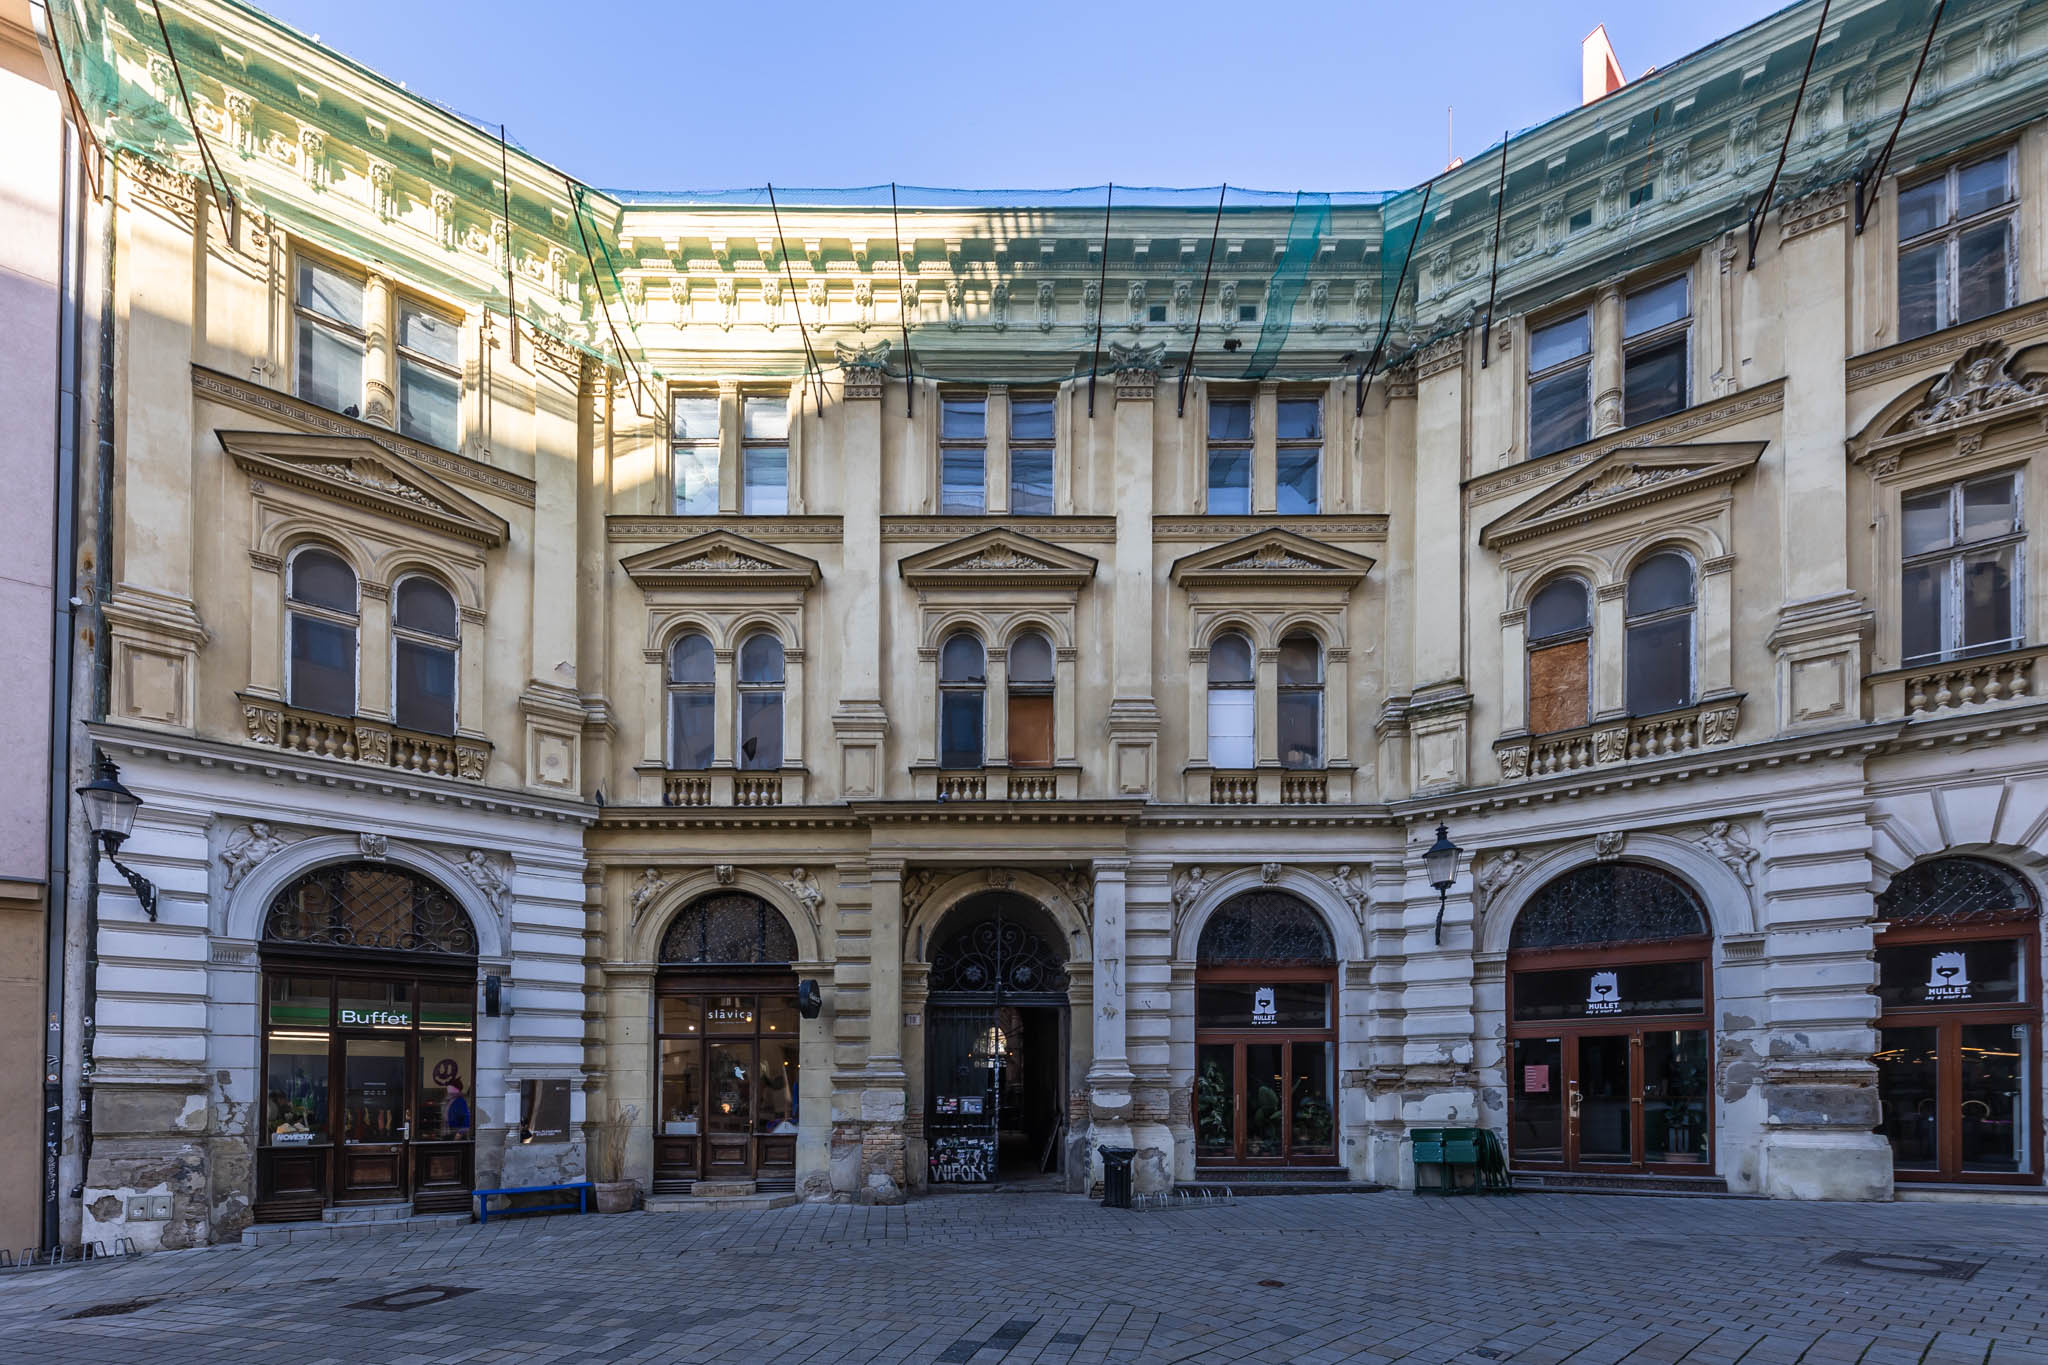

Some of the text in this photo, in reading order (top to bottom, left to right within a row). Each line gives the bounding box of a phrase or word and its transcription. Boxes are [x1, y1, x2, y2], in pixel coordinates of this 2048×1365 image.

[1928, 986, 1968, 995] MULLET
[1588, 1002, 1619, 1010] MULLET
[342, 1010, 408, 1025] Buffet
